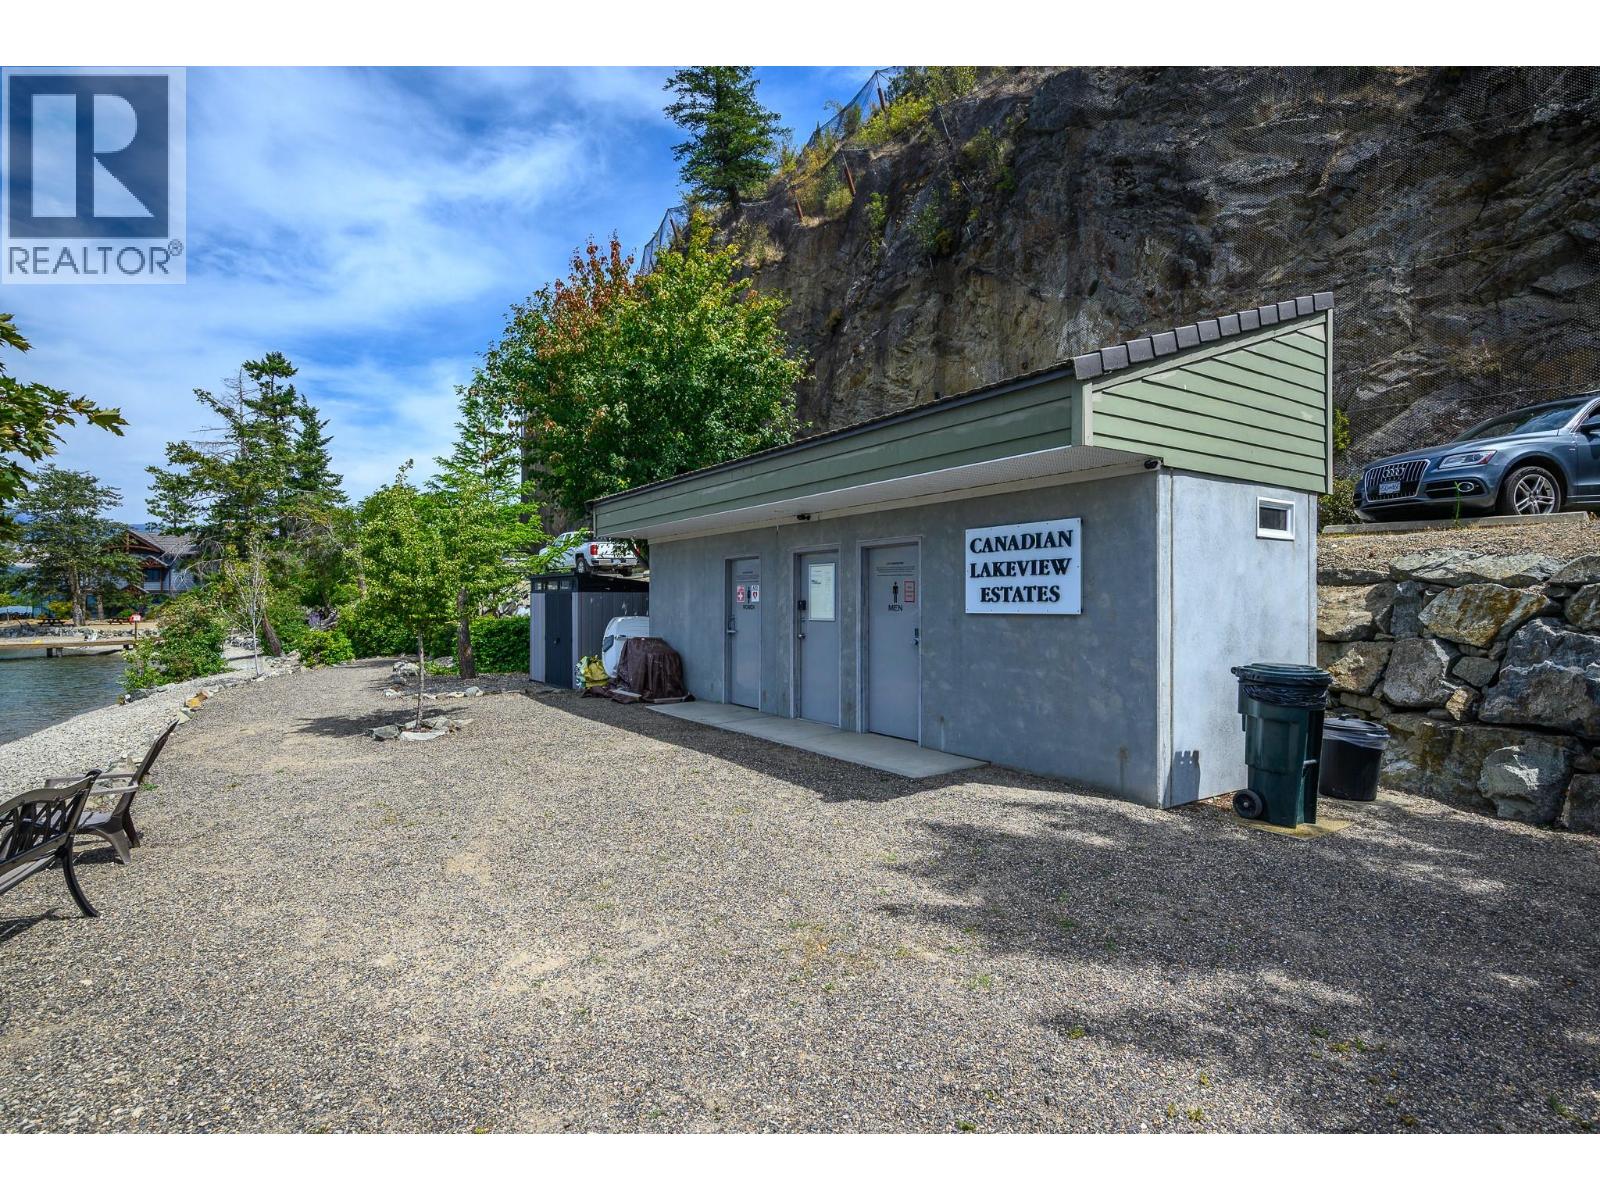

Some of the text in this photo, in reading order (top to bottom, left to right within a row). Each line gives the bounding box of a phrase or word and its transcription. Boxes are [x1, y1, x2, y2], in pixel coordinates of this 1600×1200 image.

[969, 529, 1073, 554] CANADIAN
[969, 557, 1072, 579] LAKEVIEW
[980, 585, 1061, 603] ESTATES
[888, 604, 903, 612] MEN
